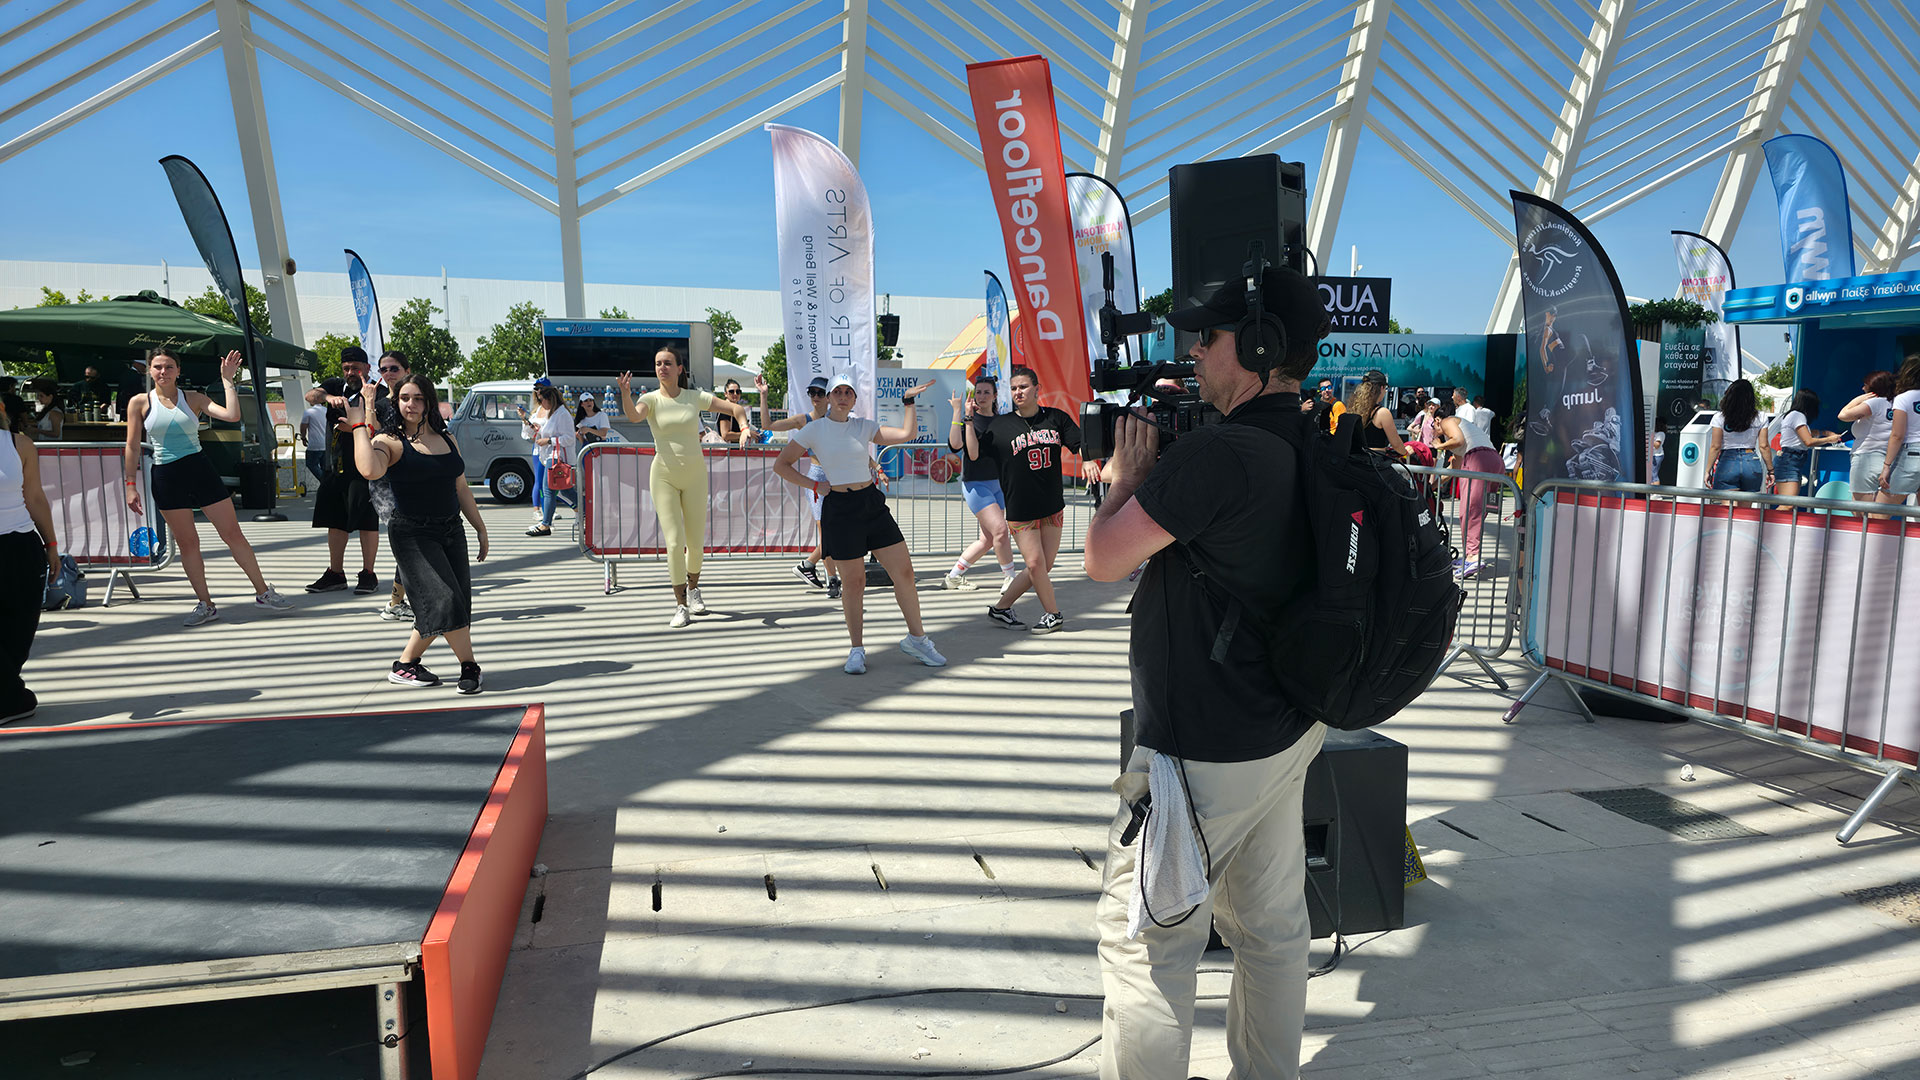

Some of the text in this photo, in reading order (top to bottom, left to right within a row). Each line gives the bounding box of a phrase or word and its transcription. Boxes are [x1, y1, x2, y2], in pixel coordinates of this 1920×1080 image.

[1318, 283, 1379, 313] QUA
[1805, 290, 1837, 303] allwyn
[1841, 285, 1870, 298] Παίξε
[1330, 315, 1379, 327] ATICA
[1318, 343, 1424, 358] ON STATION
[1664, 342, 1690, 354] Ευεξία
[1664, 352, 1683, 360] κάθε
[1663, 361, 1699, 370] σταγόνα!
[877, 377, 918, 388] ΥΣΗ ΑΝΕΥ
[1011, 433, 1027, 456] LOS
[1028, 447, 1052, 470] 91
[1346, 522, 1360, 575] DAINESE
